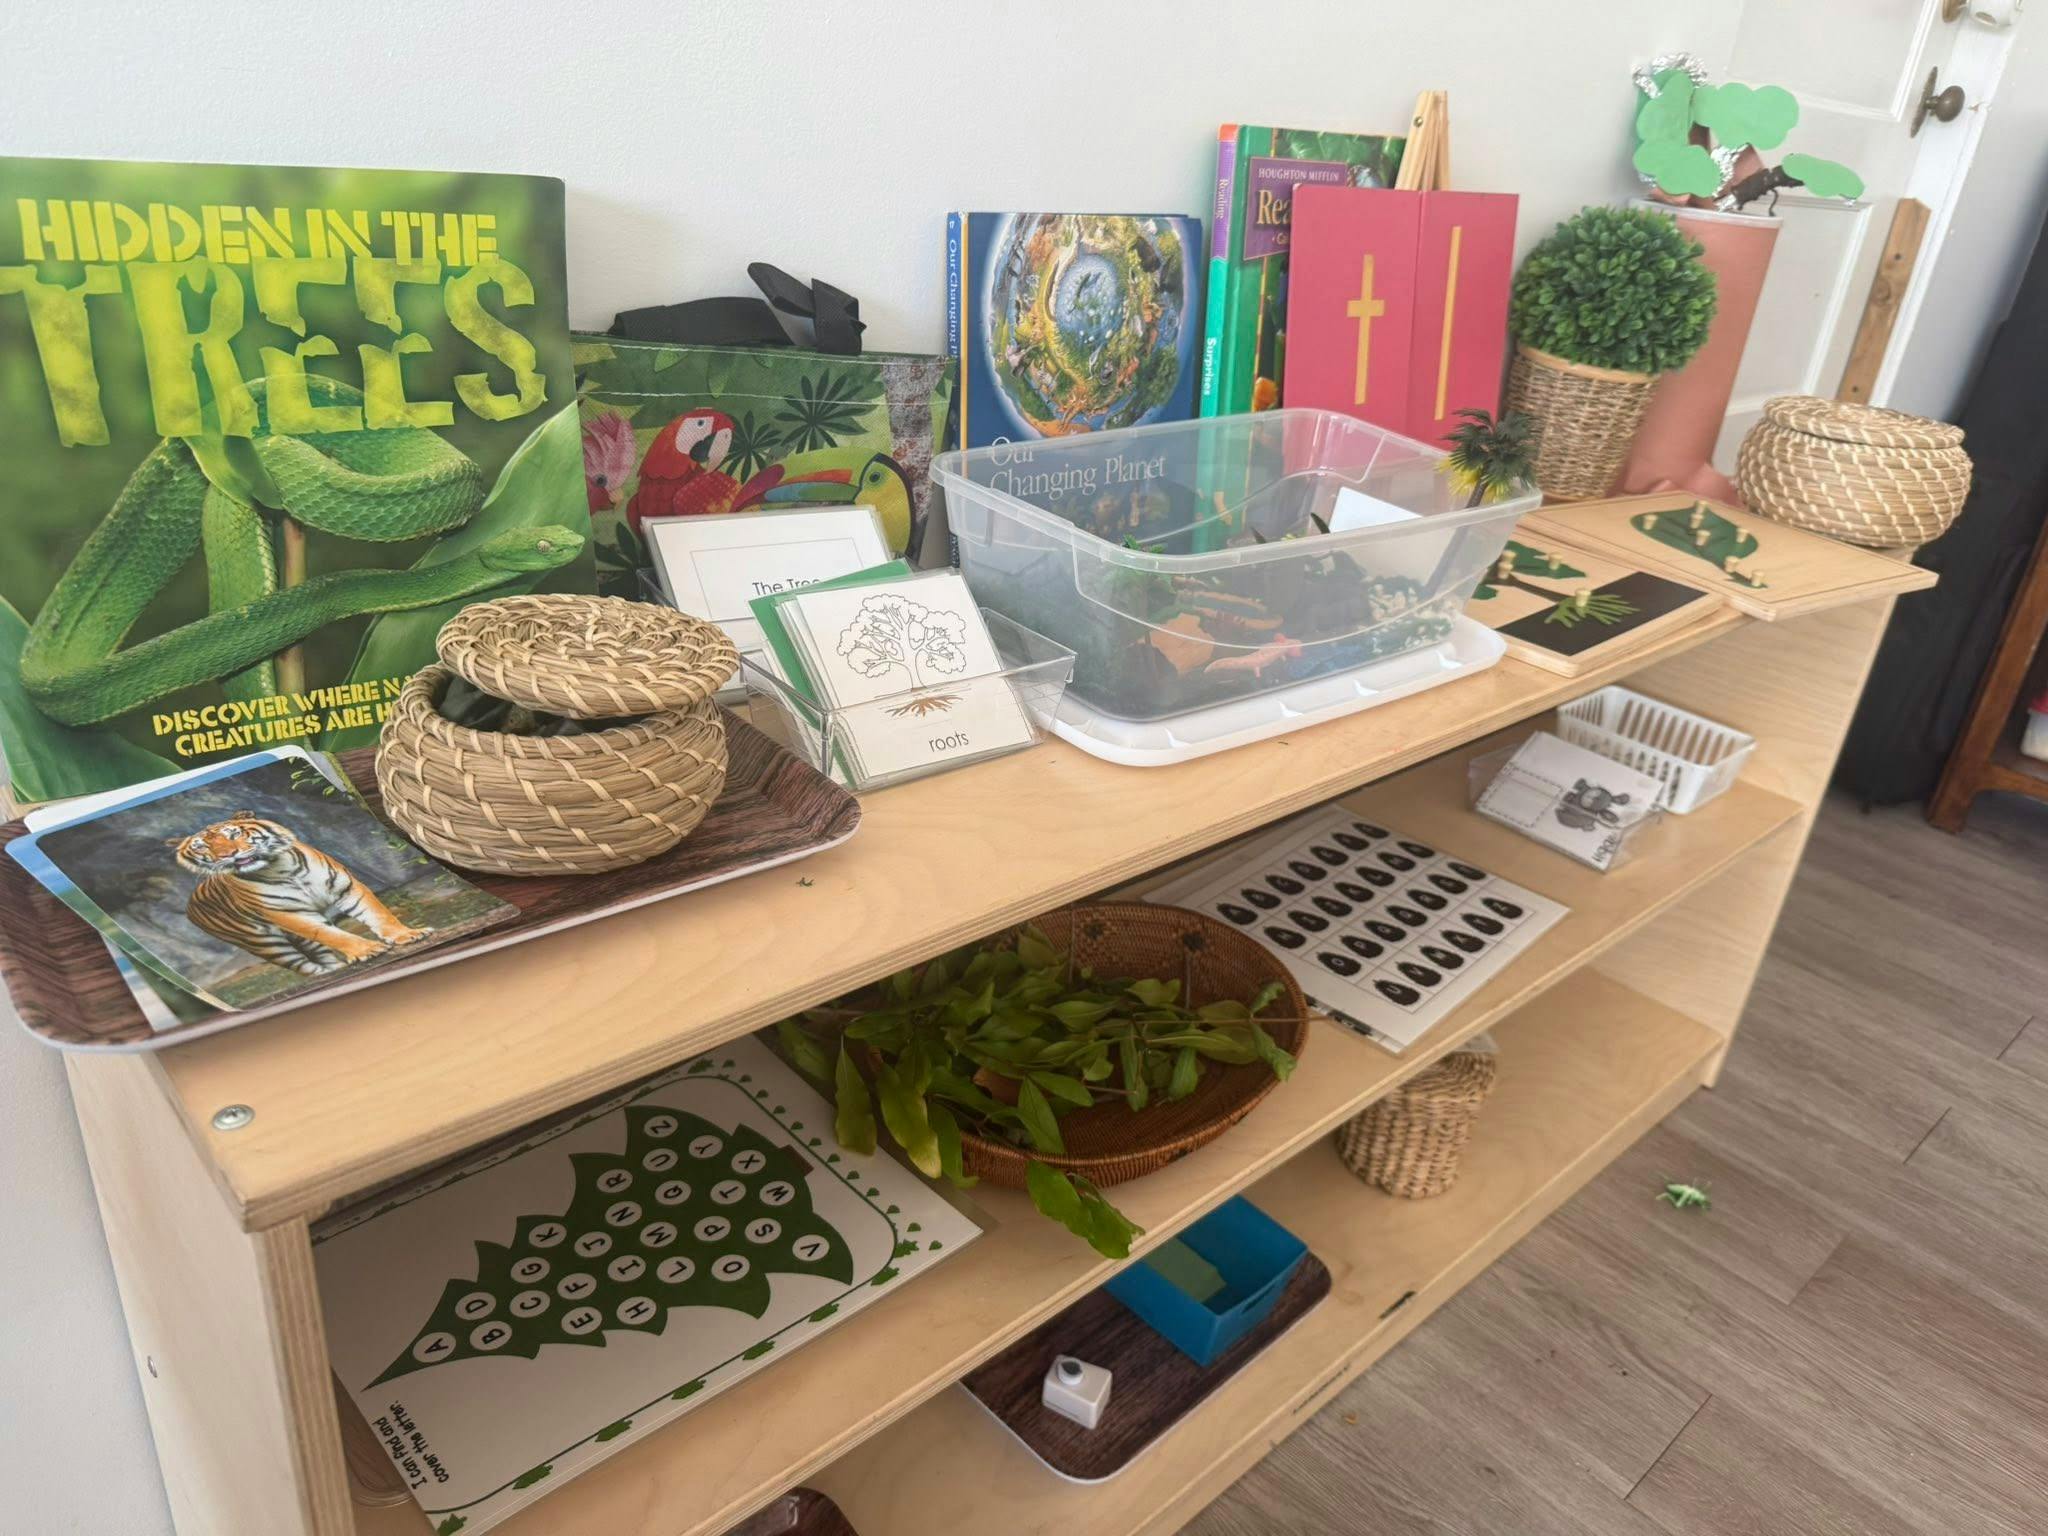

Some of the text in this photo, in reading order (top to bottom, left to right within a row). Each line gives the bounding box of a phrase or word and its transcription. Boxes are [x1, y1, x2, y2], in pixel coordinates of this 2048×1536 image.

[1257, 167, 1340, 182] HOUGHTON MIFFLIN
[16, 198, 498, 266] HIDDEN IN THE
[0, 253, 549, 448] TREES
[1203, 337, 1217, 396] Surprises
[990, 454, 1167, 500] Changing Planet
[991, 436, 1034, 466] Our
[752, 582, 783, 596] The
[152, 694, 291, 736] DISCOVER
[293, 680, 380, 712] WHERE
[175, 714, 321, 757] CREATURES
[325, 706, 374, 732] ARE
[928, 730, 969, 752] roots
[650, 1120, 820, 1257] V W X Y Z
[650, 1154, 774, 1237] S T U
[605, 1173, 743, 1274] O P Q R
[611, 1206, 687, 1278] L M N
[521, 1263, 594, 1329] E F G
[536, 1227, 650, 1319] H I J K
[424, 1338, 449, 1354] A
[465, 1297, 542, 1345] B C D
[372, 1416, 427, 1489] I can find and
[390, 1400, 449, 1483] cover the letter.
